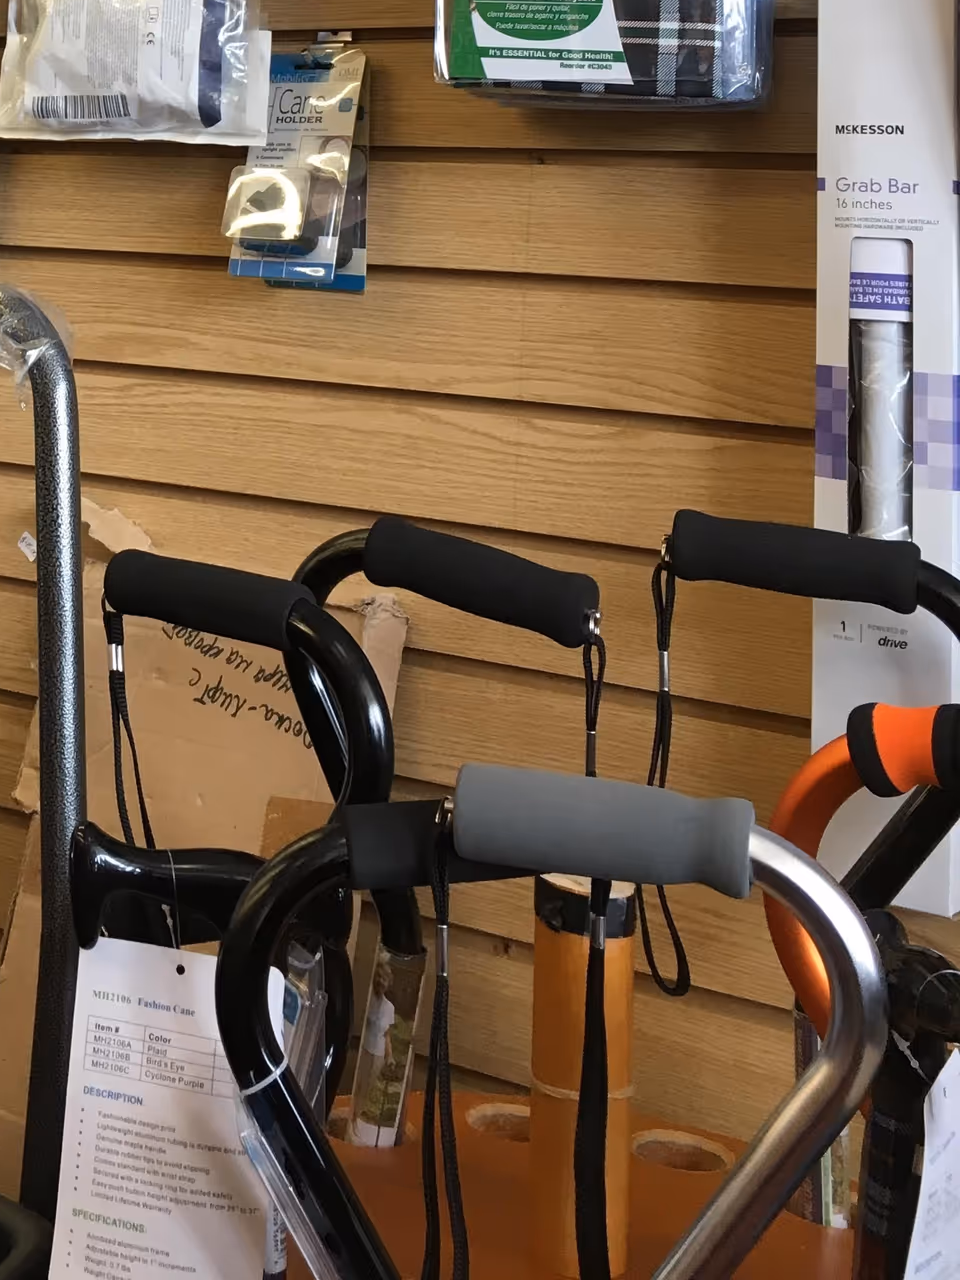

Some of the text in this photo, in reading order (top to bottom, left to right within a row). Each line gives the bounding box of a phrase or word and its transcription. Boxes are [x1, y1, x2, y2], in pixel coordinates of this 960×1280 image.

[488, 49, 614, 60] It's ESSENTIAL for Good Health!
[559, 62, 586, 70] Reorder
[278, 88, 325, 115] Cane
[275, 115, 323, 124] HOLDER
[835, 176, 920, 195] Grab Bar
[836, 197, 893, 211] 16 inches
[883, 295, 911, 306] BATH
[840, 620, 846, 633] 1
[877, 636, 908, 650] drive
[92, 989, 197, 1018] MH2106 Fashion Cane
[94, 1022, 172, 1045] Item Color
[93, 1034, 168, 1057] MH2106A Plaid
[92, 1047, 186, 1073] MH2106B Eye
[91, 1059, 205, 1090] MH2106C Cyclone Purple
[82, 1085, 144, 1107] DESCRIPTION
[96, 1121, 134, 1137] Lightweight
[139, 1118, 160, 1132] design
[95, 1144, 120, 1157] Durable
[93, 1155, 146, 1175] Comes standard
[93, 1167, 119, 1180] Secured
[141, 1201, 172, 1216] Warranty
